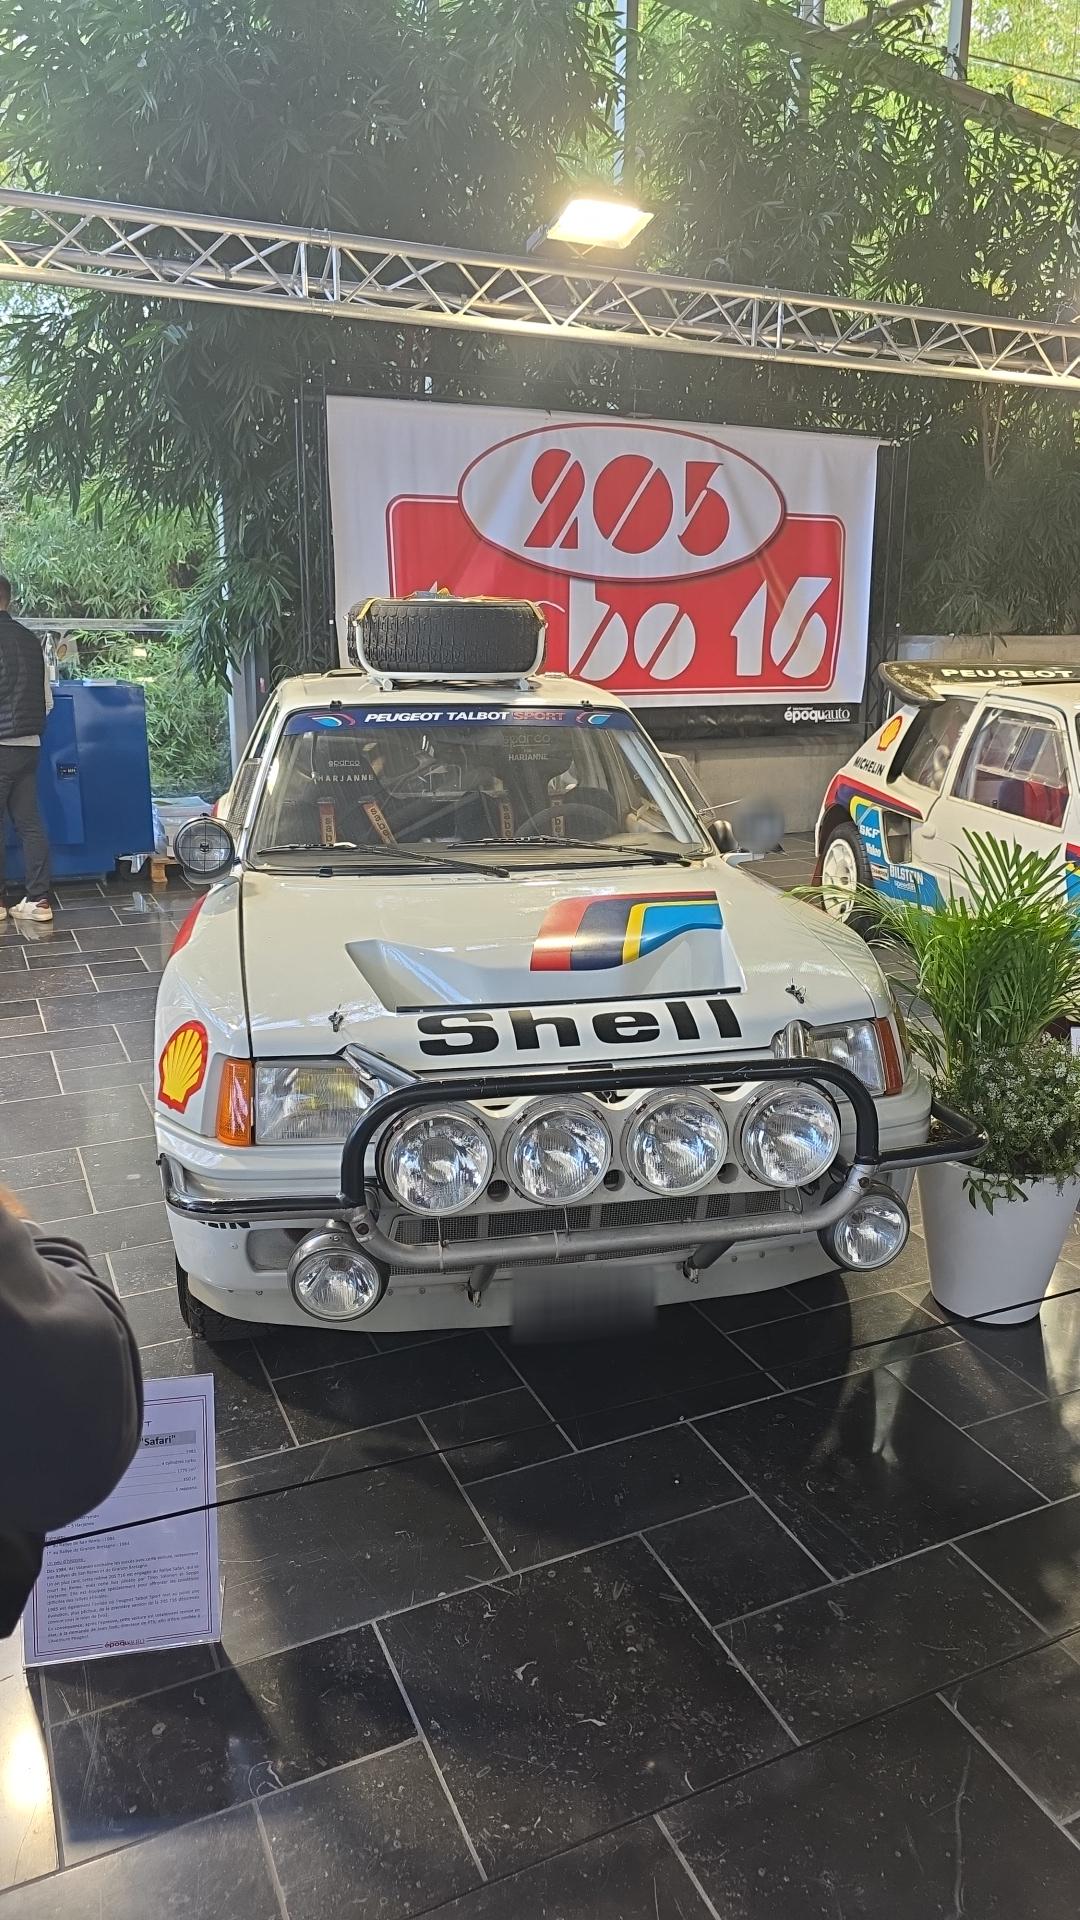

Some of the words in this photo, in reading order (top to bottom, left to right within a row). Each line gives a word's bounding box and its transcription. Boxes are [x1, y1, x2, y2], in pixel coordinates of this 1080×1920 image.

[524, 449, 730, 556] 205
[730, 577, 832, 679] 16
[941, 668, 1073, 679] PEUGEOT
[364, 711, 443, 723] PEUGEOT
[446, 711, 510, 721] TALBOT
[512, 711, 567, 721] SPORT
[784, 706, 851, 723] époquauto
[853, 756, 886, 776] MICHELIN
[859, 824, 881, 839] SKF
[417, 999, 742, 1056] Shell
